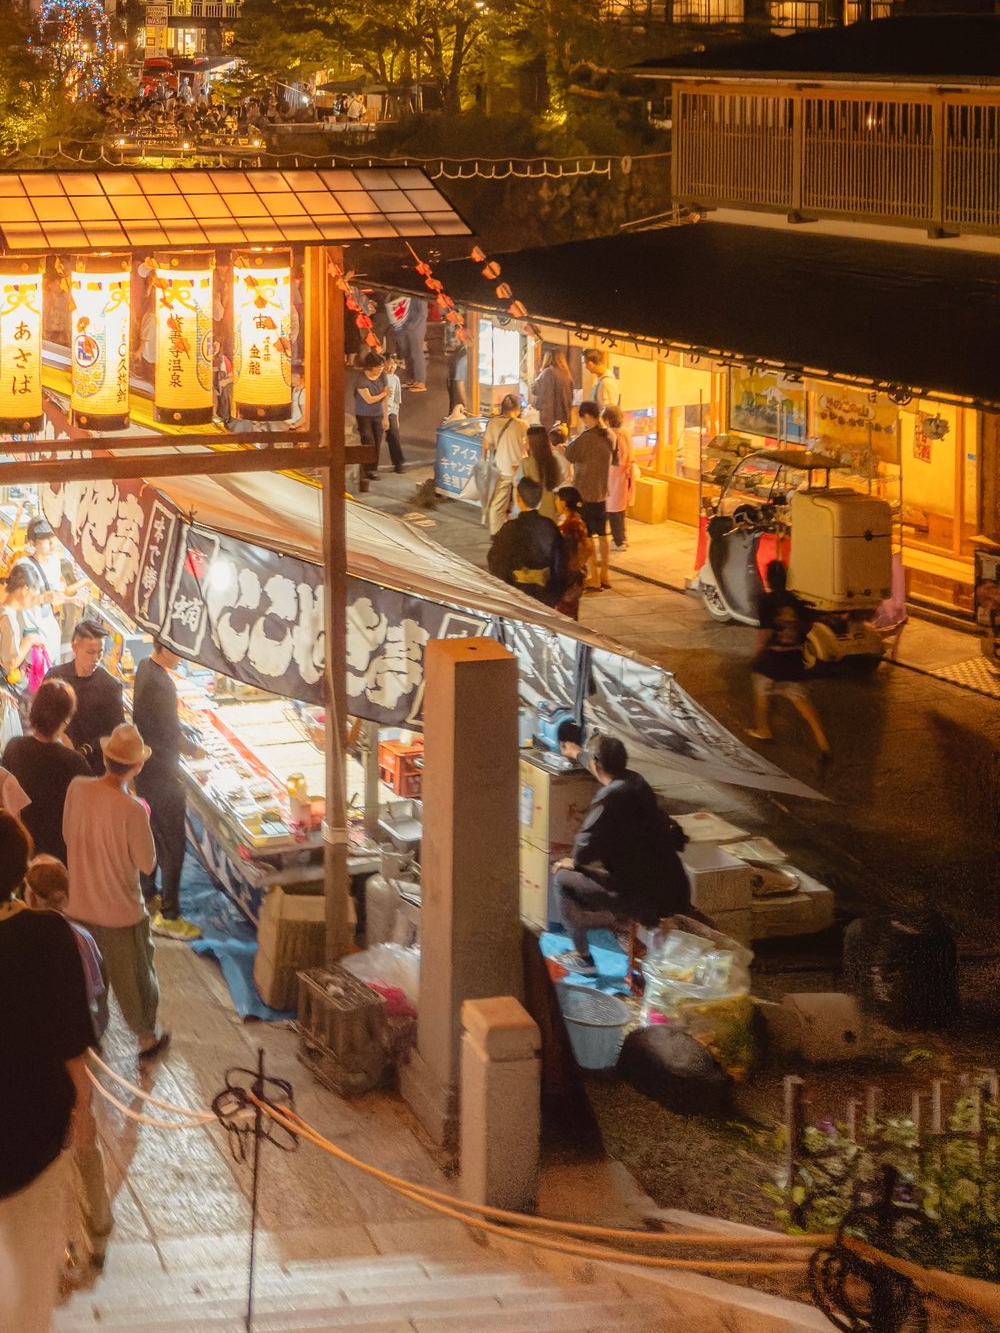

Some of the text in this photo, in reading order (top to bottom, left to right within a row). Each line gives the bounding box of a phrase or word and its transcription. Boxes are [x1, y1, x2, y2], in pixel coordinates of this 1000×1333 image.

[12, 320, 33, 396] あさば
[450, 444, 478, 462] アイス
